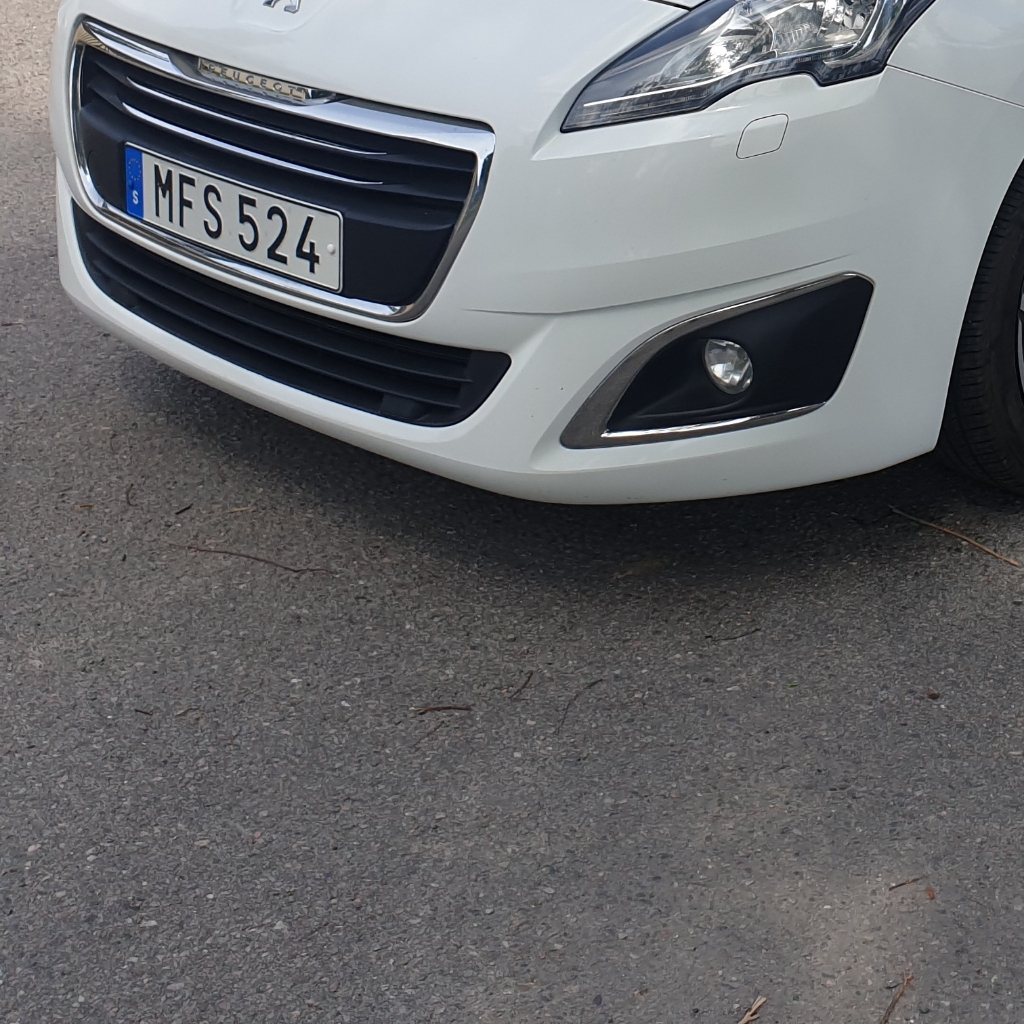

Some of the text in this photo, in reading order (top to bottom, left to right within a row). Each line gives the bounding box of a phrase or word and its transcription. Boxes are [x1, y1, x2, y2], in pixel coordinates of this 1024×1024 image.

[208, 62, 297, 96] PEUGEOT
[132, 189, 139, 205] S
[154, 163, 320, 274] MFS 524
